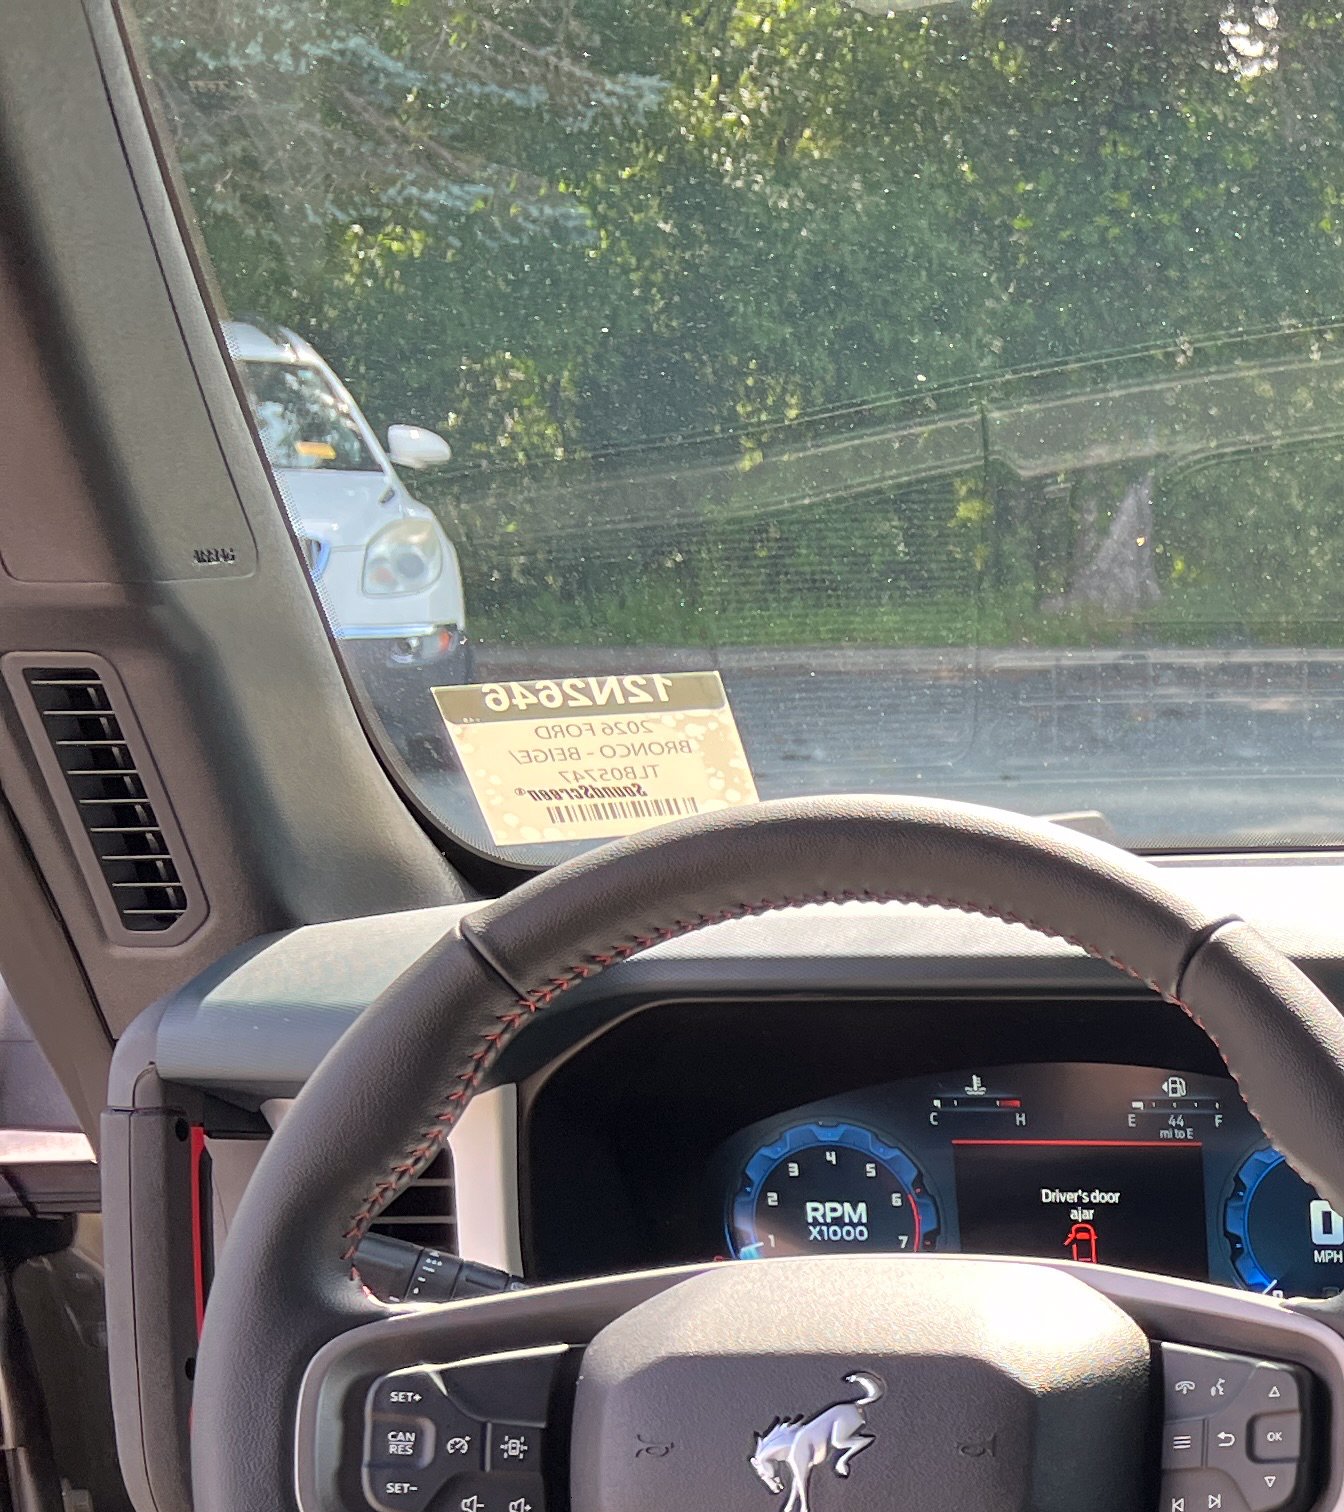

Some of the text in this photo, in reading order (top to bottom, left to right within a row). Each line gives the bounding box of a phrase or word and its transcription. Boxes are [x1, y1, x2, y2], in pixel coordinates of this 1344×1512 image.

[929, 1112, 938, 1126] C
[1015, 1113, 1026, 1126] H
[1127, 1114, 1136, 1127] E
[1167, 1115, 1185, 1128] 44
[1214, 1114, 1223, 1128] F
[1159, 1128, 1194, 1139] mi to E
[825, 1151, 837, 1165] 4
[787, 1163, 799, 1177] 3
[865, 1163, 877, 1178] 5
[766, 1192, 779, 1206] 2
[891, 1192, 902, 1206] 6
[1041, 1189, 1121, 1205] Driver's door
[805, 1201, 868, 1224] RPM
[1069, 1206, 1094, 1221] ajar
[808, 1225, 868, 1242] X1000
[768, 1235, 776, 1248] 1
[898, 1235, 909, 1249] 7
[1313, 1249, 1344, 1264] MPH
[390, 1391, 422, 1403] SET+
[387, 1431, 416, 1442] CAN
[1266, 1431, 1283, 1442] OK
[388, 1444, 413, 1456] RES
